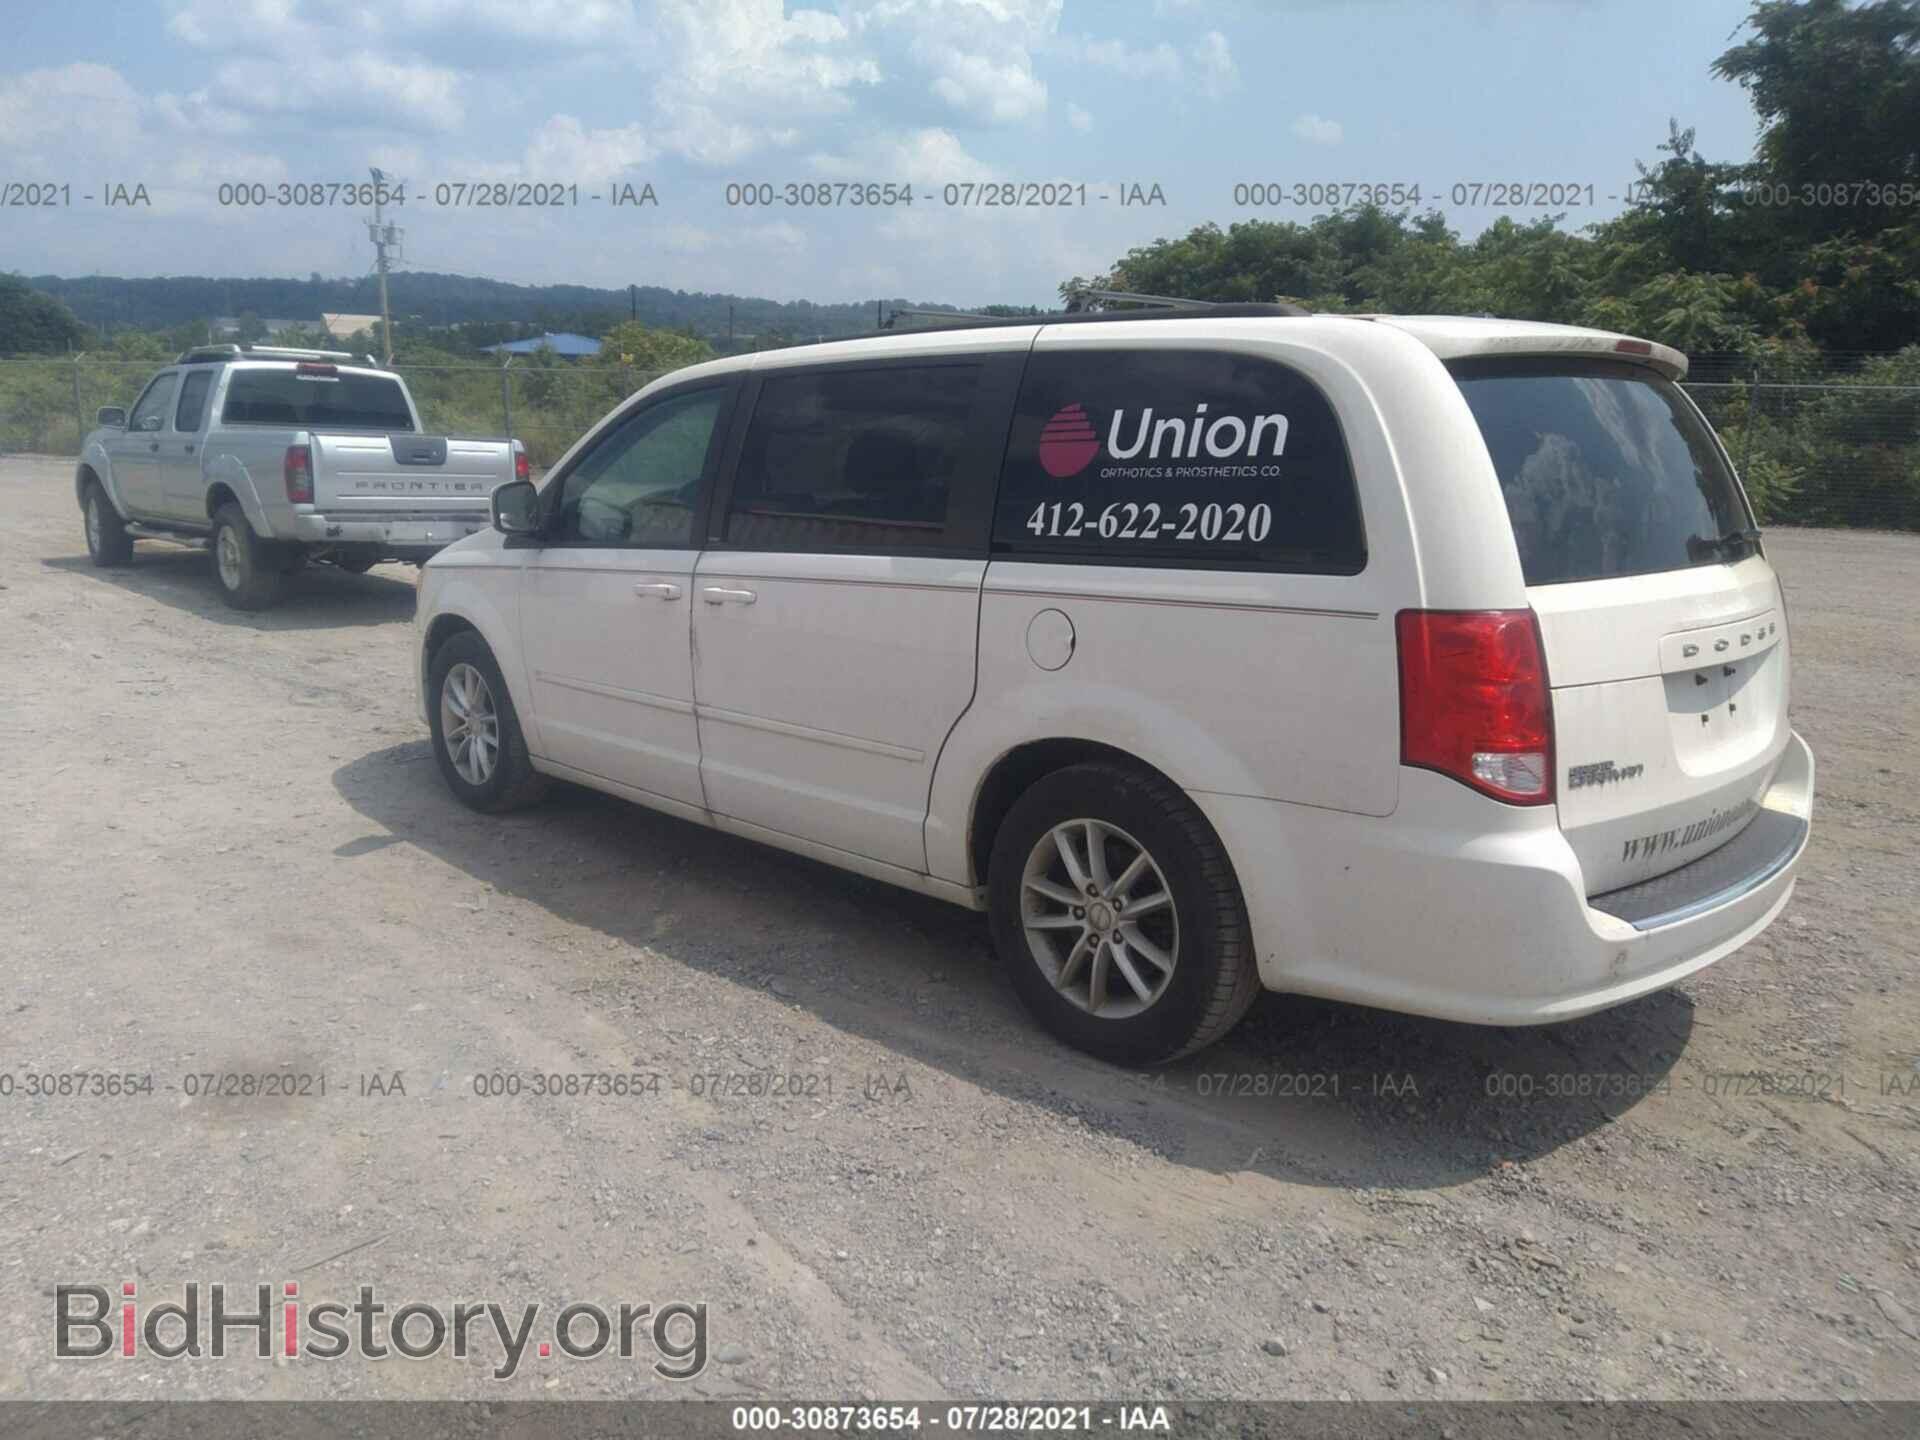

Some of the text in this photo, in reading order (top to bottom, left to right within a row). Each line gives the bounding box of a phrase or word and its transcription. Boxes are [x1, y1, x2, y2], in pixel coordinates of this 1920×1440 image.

[1107, 403, 1289, 459] Union
[1100, 467, 1162, 478] ORTHOTICS
[1165, 467, 1173, 478] &
[1177, 467, 1257, 478] PROSTHETICS
[1026, 501, 1272, 542] 412-622-2020
